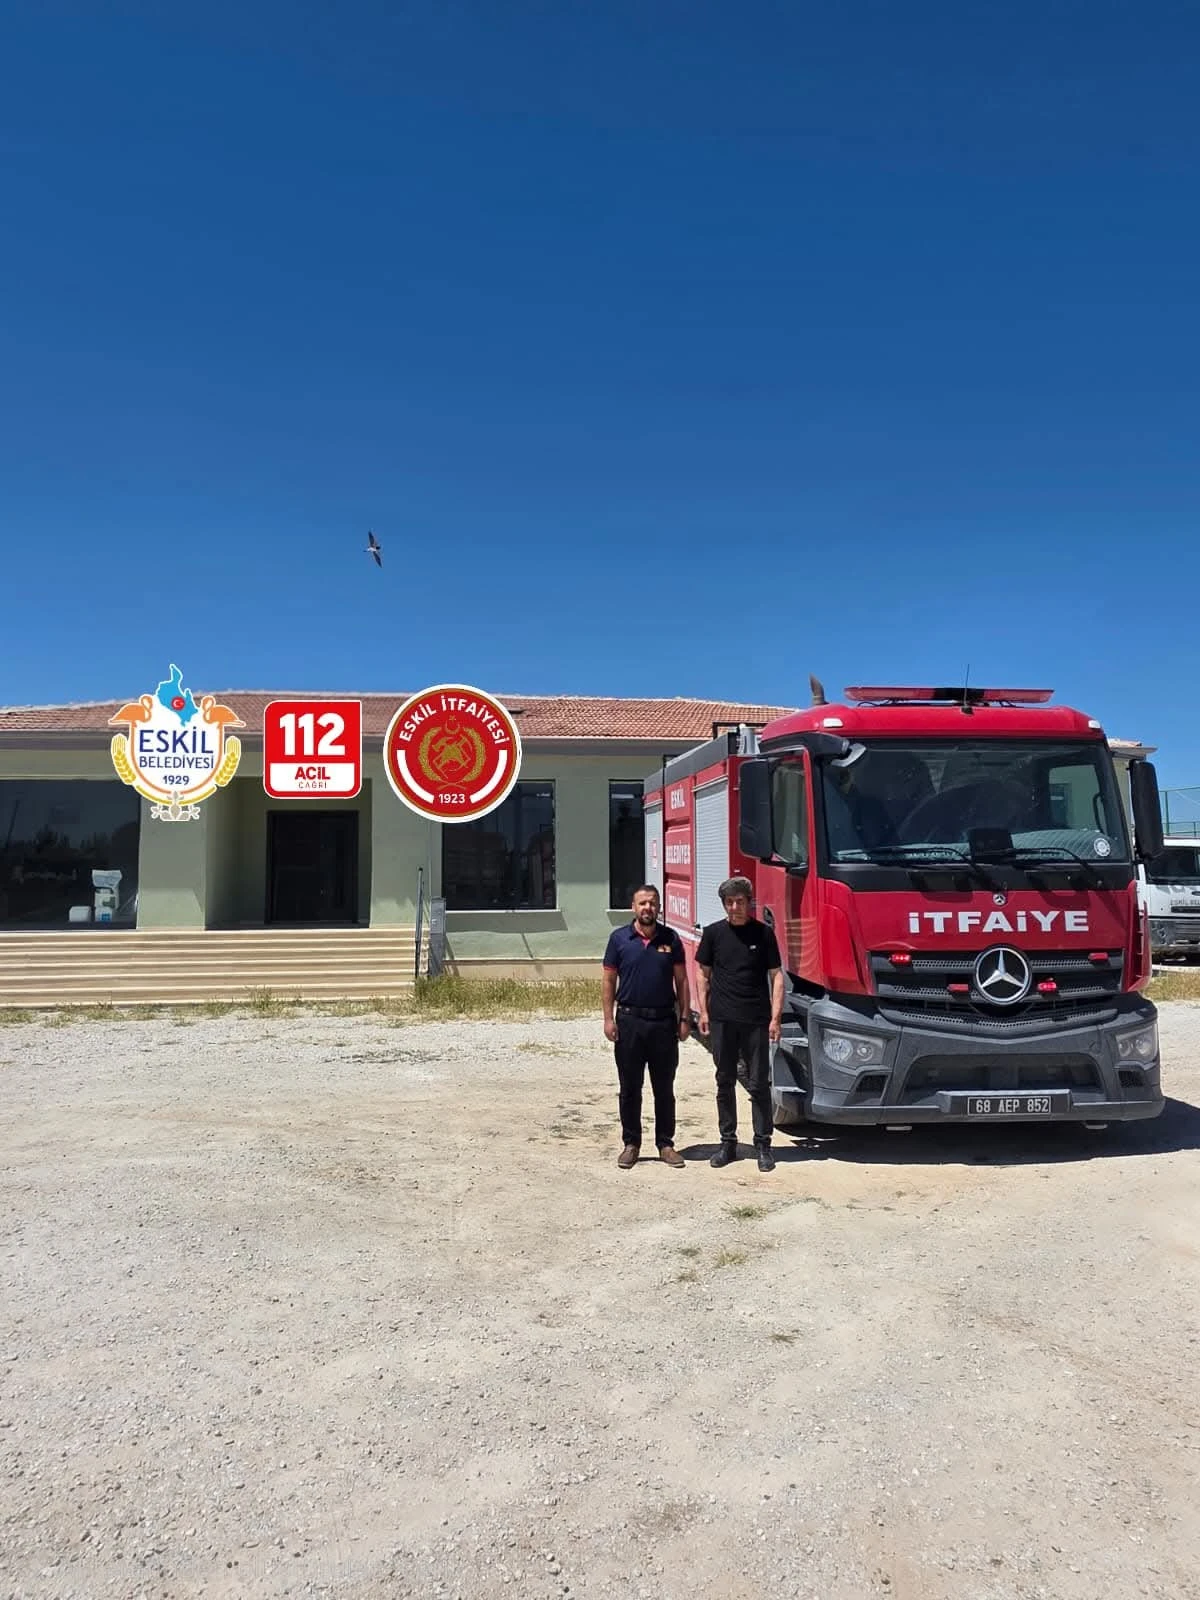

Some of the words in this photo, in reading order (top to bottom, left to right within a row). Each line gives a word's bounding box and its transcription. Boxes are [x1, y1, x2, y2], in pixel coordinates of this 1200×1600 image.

[976, 1099, 991, 1113] 68
[998, 1099, 1020, 1113] AEP
[1027, 1098, 1049, 1113] 852
